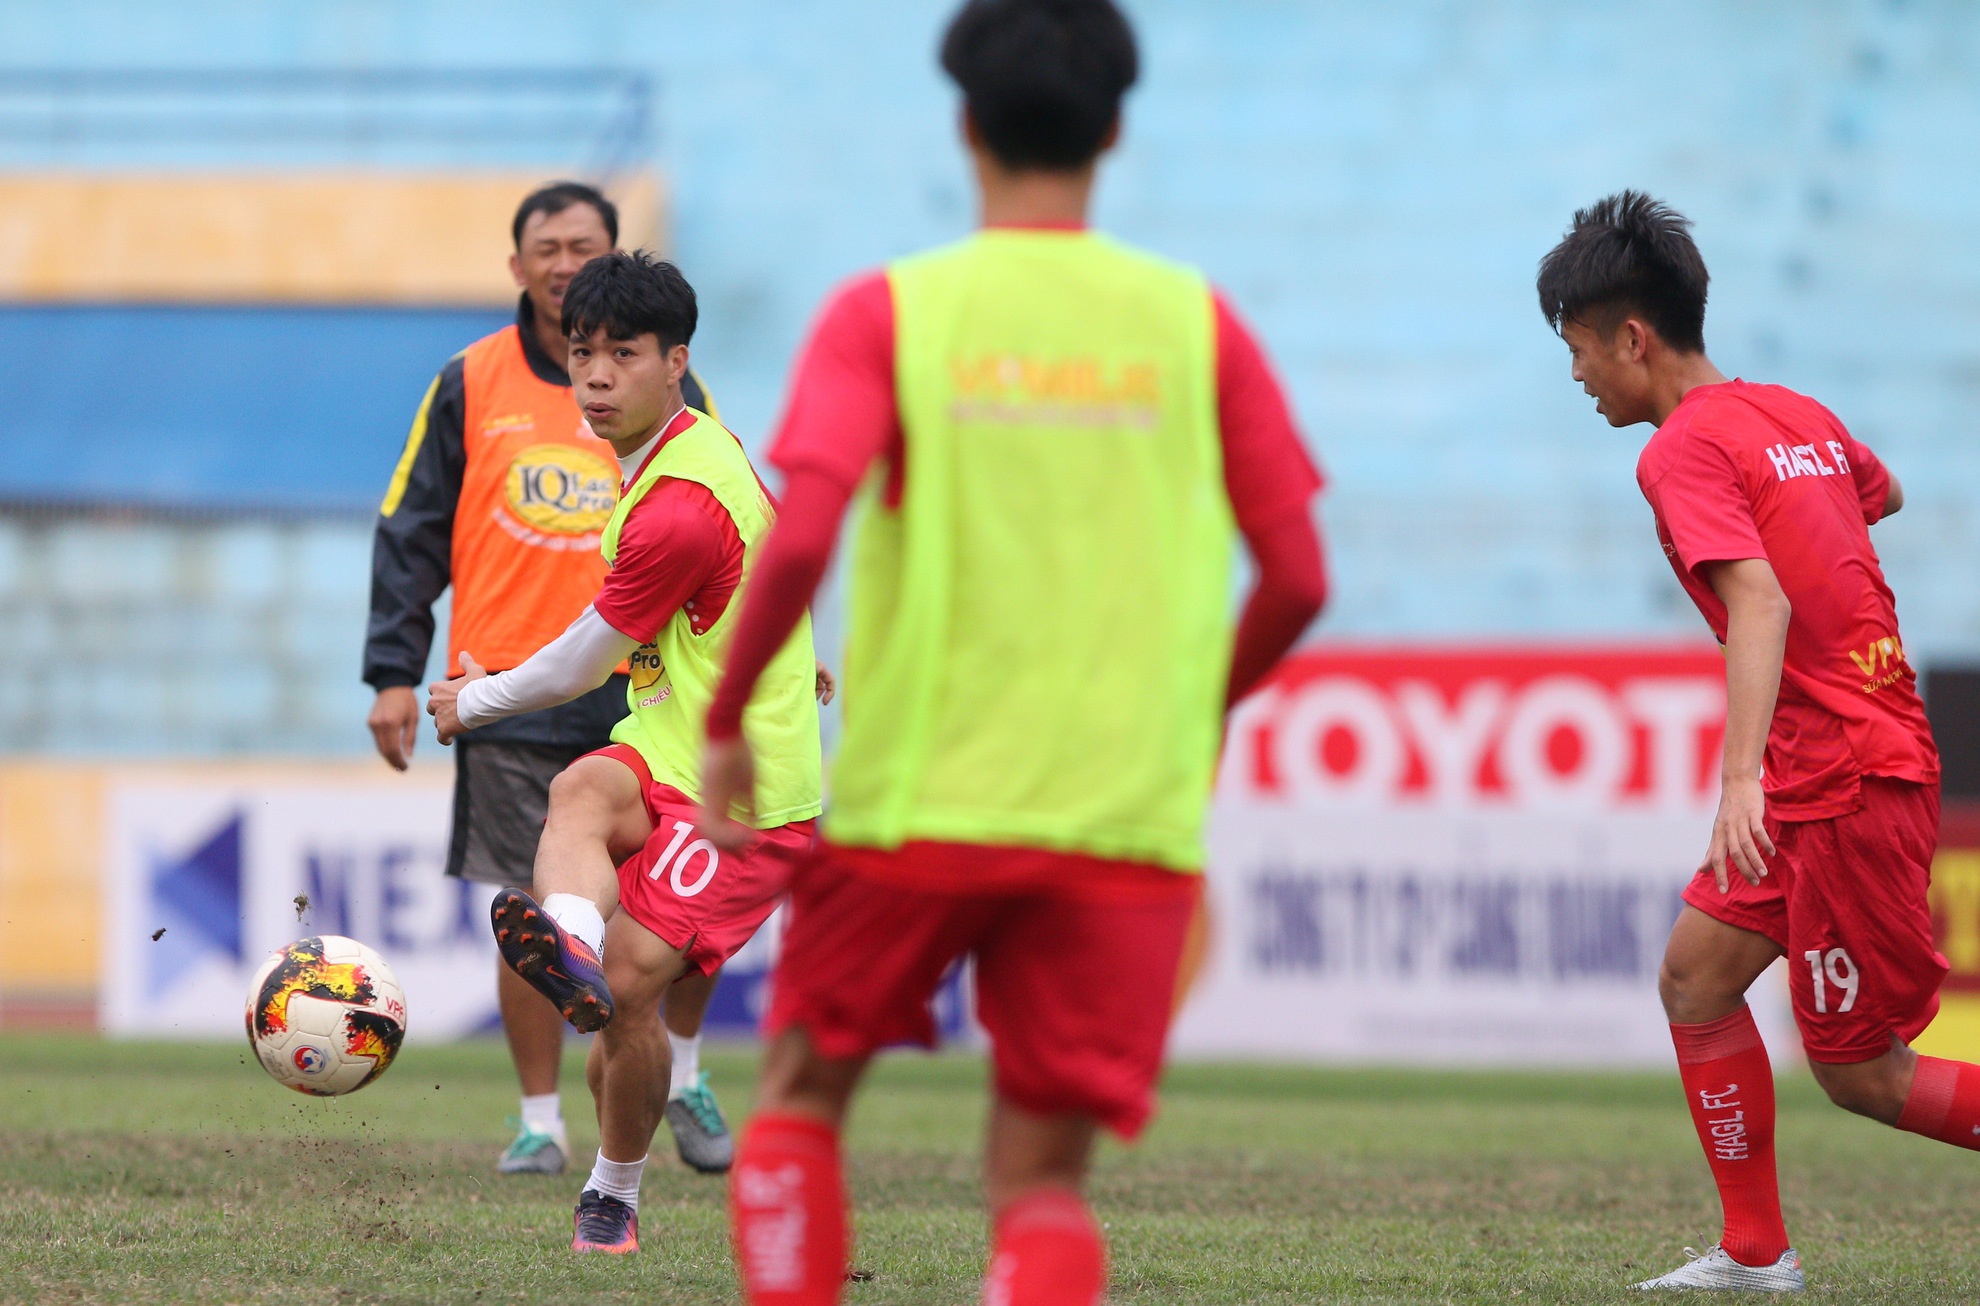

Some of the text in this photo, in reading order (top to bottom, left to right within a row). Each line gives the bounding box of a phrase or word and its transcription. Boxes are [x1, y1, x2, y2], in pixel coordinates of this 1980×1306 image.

[519, 464, 580, 512] IQ
[1765, 440, 1851, 482] HAGL F
[630, 651, 661, 669] Pro
[1220, 676, 1727, 800] TOYOT
[649, 821, 719, 897] 10
[1805, 948, 1859, 1013] 19
[1700, 1083, 1748, 1160] HAGL FC
